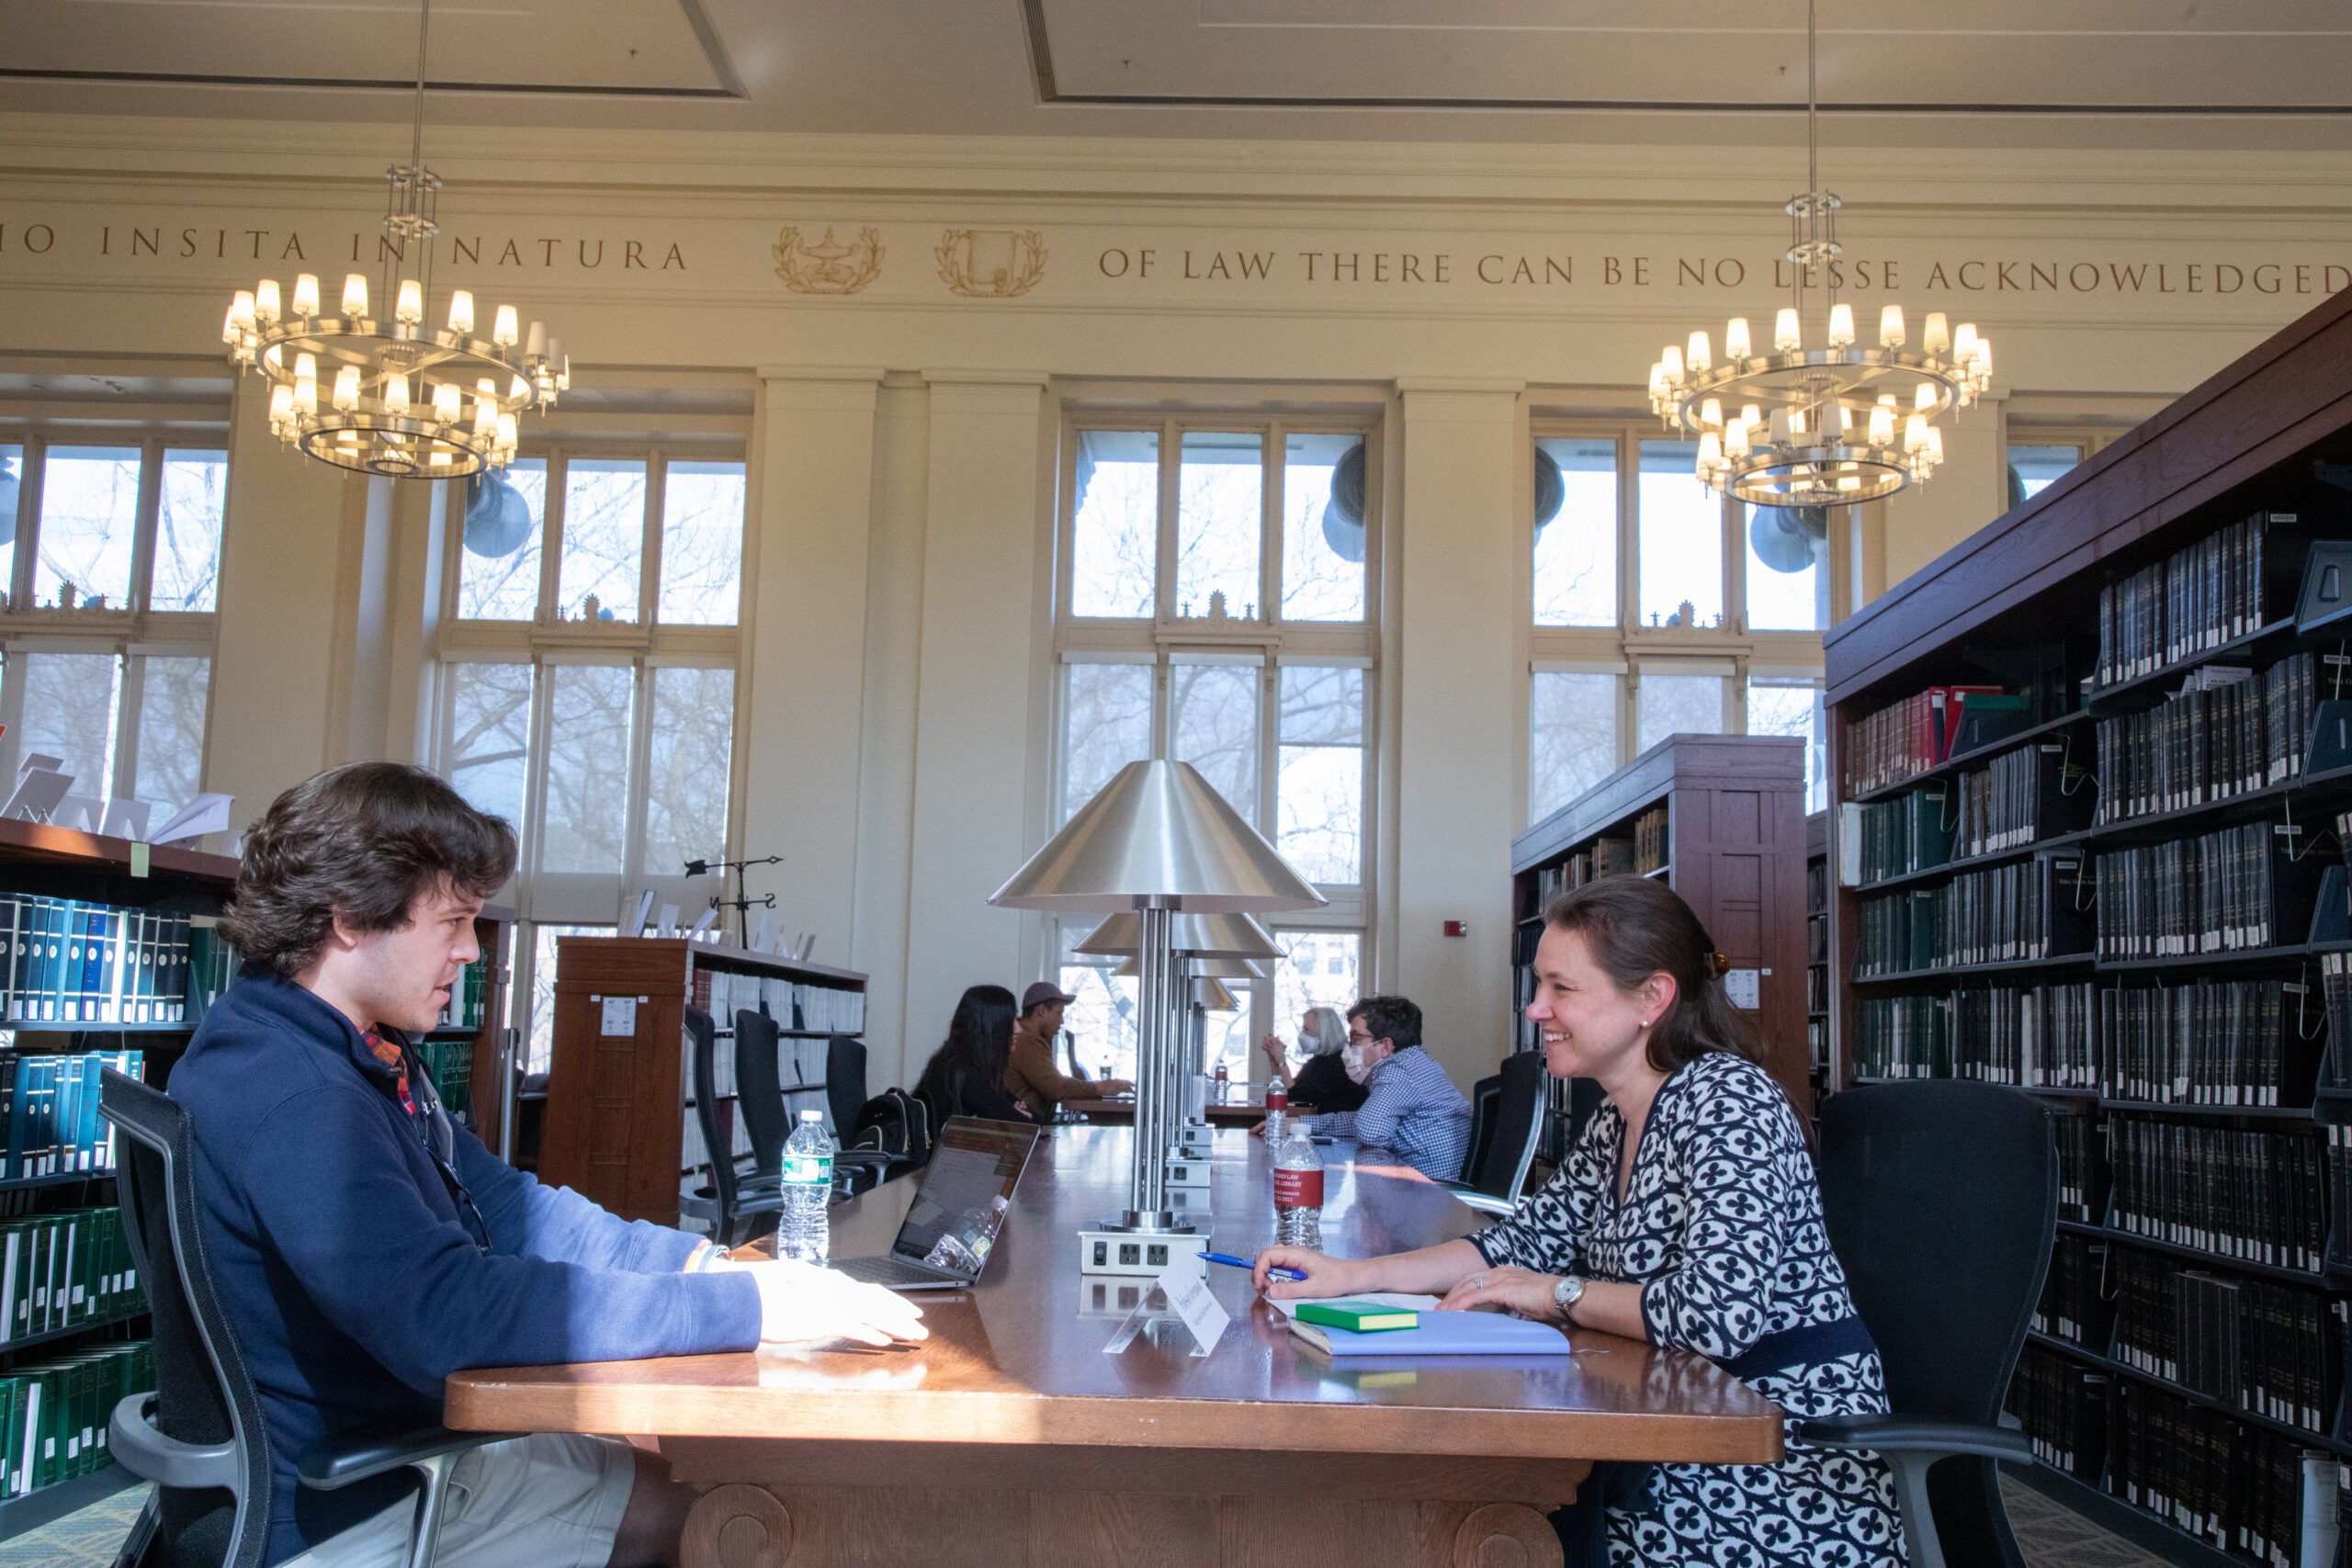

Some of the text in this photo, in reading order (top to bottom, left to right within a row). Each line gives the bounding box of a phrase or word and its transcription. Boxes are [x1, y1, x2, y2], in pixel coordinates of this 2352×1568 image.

[101, 226, 307, 260] INSITA
[351, 233, 406, 263] IN
[452, 236, 687, 270] NATURA
[1099, 249, 2352, 294] OF LAW THERE CAN BE NO LESSE ACKNOWLEDGED
